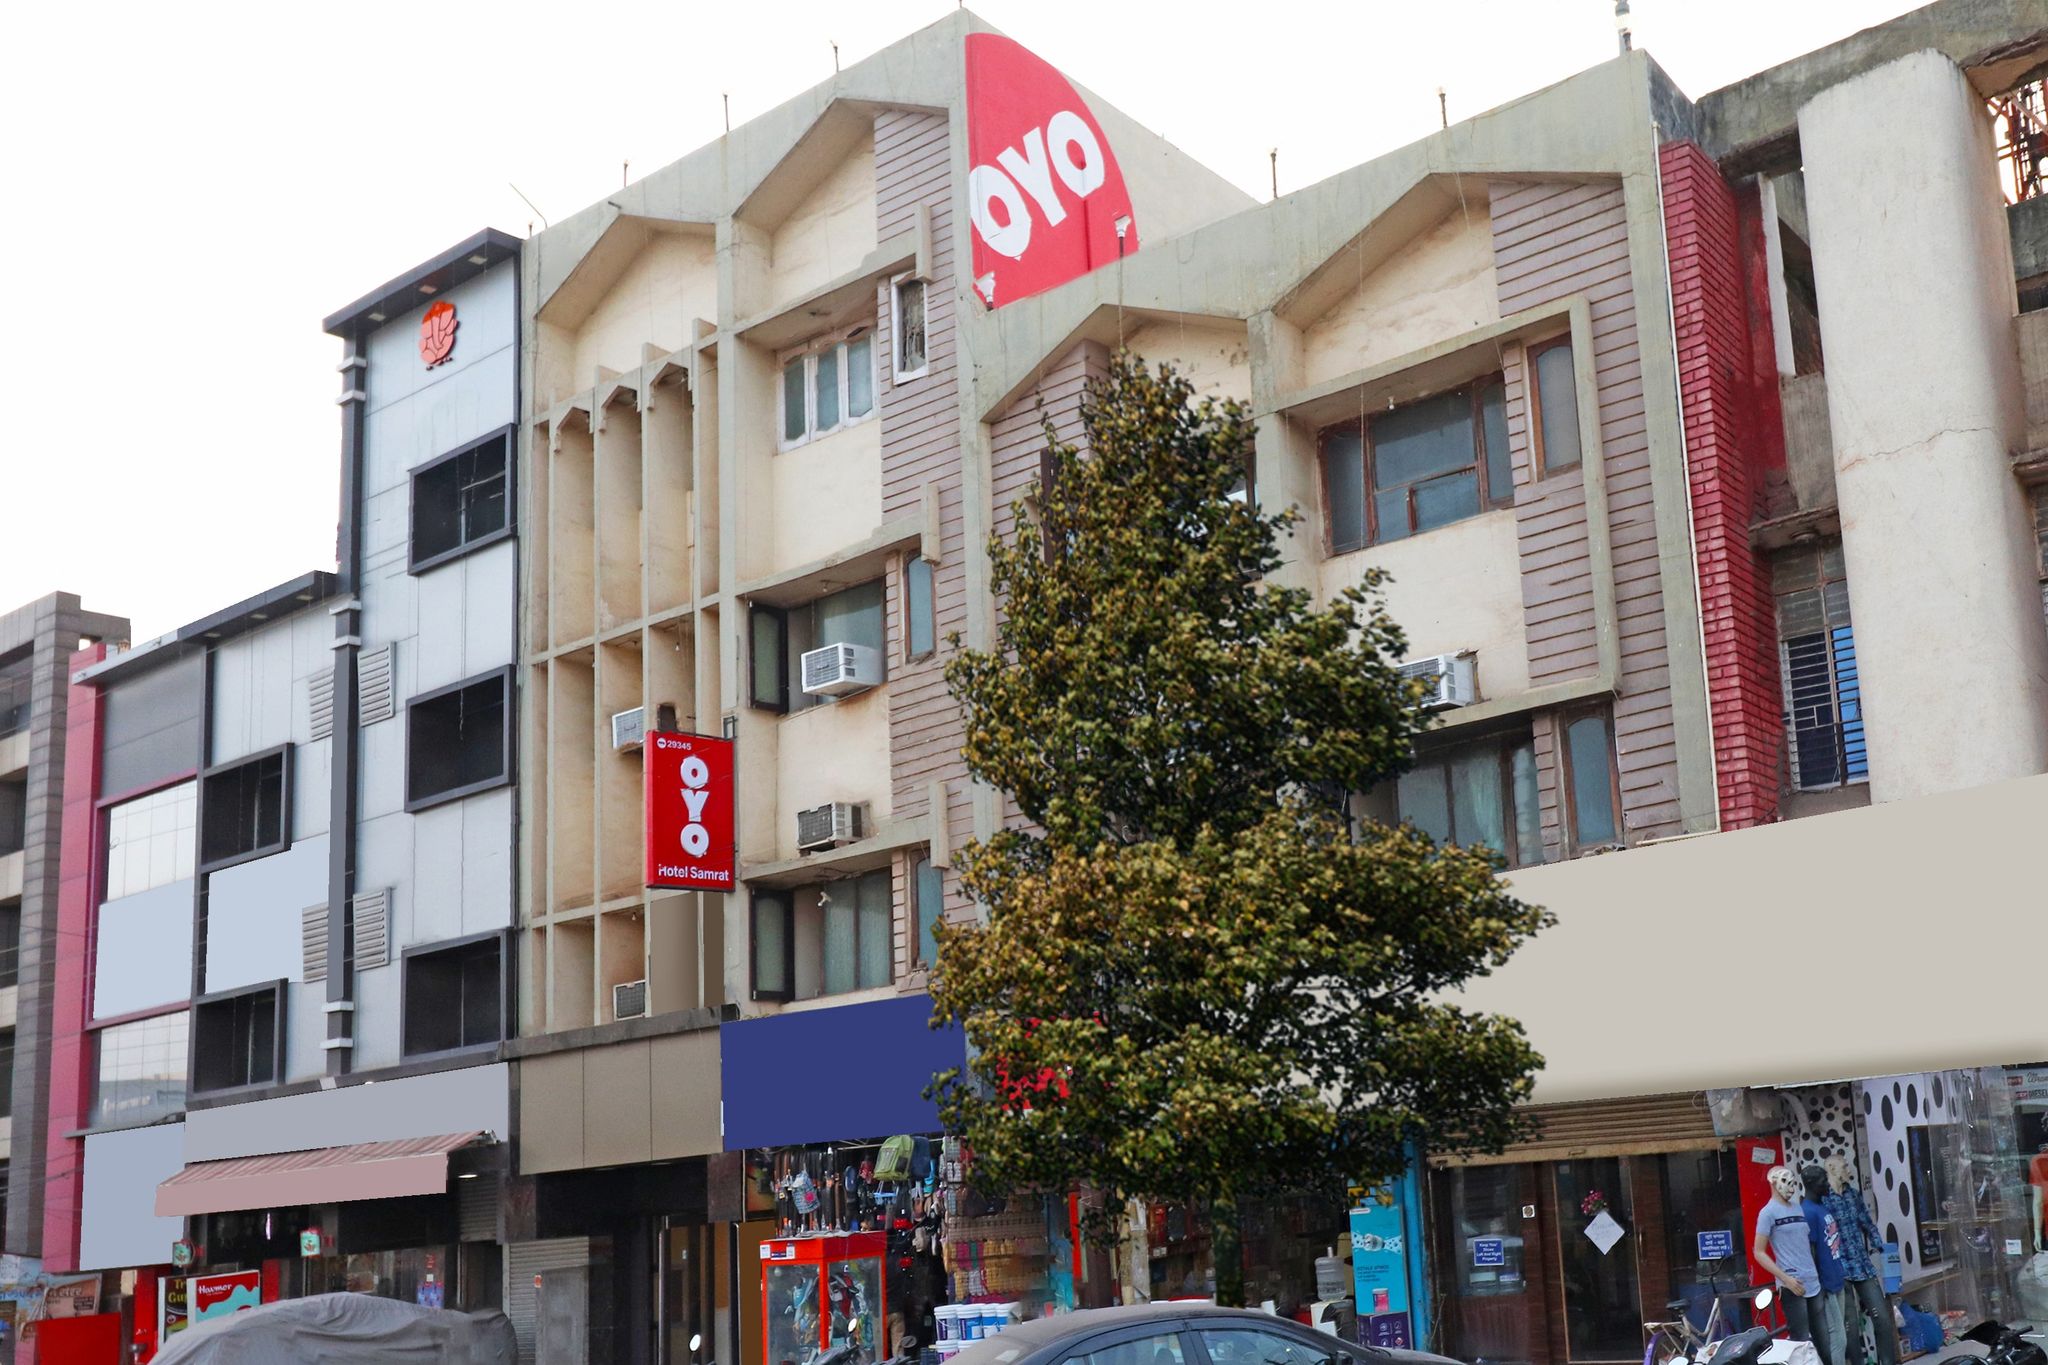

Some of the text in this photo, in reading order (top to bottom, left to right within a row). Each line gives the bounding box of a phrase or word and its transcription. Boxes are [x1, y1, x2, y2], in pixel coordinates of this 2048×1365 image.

[969, 111, 1105, 258] OYO
[680, 755, 709, 858] OYO
[658, 864, 729, 881] Hotel Samrat
[198, 1283, 233, 1294] Havmor
